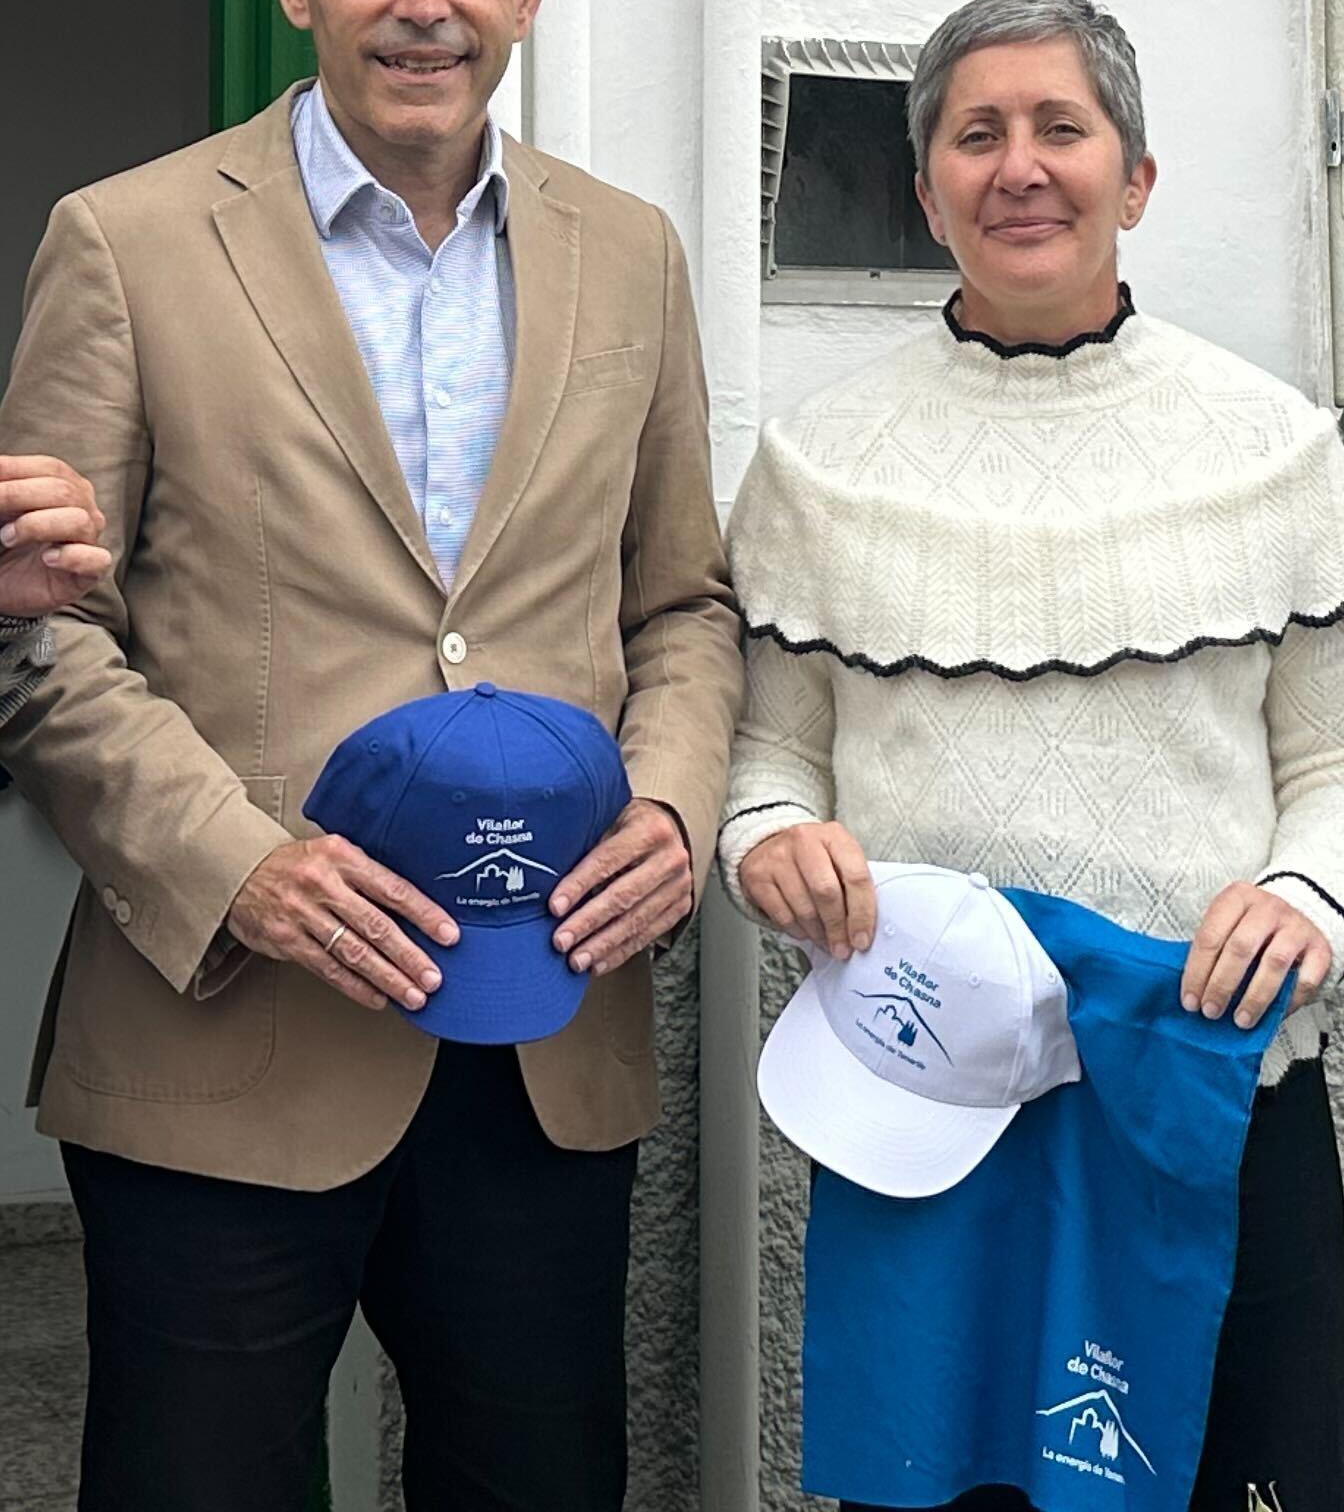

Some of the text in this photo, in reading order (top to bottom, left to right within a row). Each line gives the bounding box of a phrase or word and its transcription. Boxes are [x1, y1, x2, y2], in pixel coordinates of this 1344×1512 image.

[476, 817, 526, 831] Vilaflor
[464, 830, 534, 845] de Chasna
[883, 965, 942, 1009] de Chasna
[898, 957, 940, 992] Vilaflor
[1067, 1355, 1089, 1376] de
[1042, 1445, 1055, 1460] La
[1092, 1463, 1104, 1477] de
